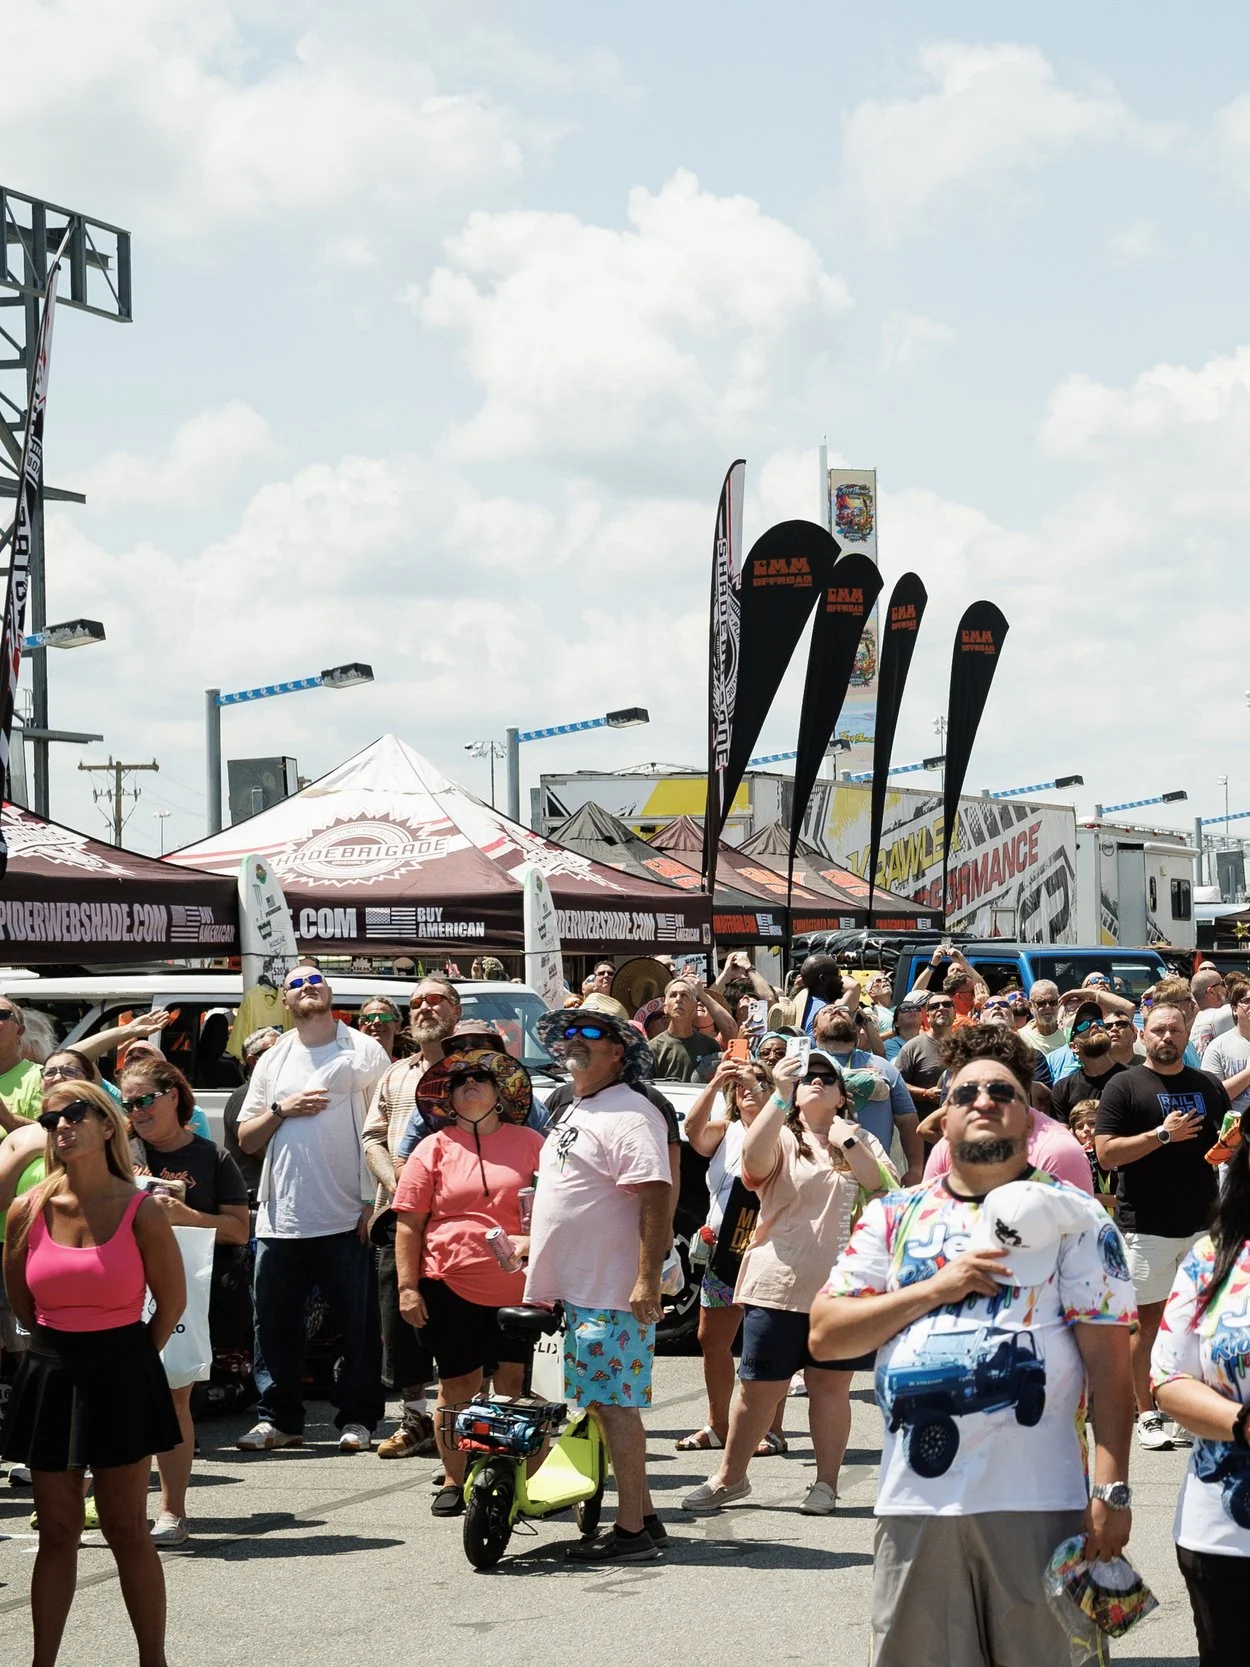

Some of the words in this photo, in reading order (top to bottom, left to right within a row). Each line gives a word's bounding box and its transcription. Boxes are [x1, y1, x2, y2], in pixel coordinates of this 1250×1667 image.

[753, 575, 812, 587] OFFROAD
[272, 837, 446, 868] HADEBRIGADE
[911, 820, 1043, 917] RFORMANCE
[200, 906, 214, 924] BUY
[289, 907, 357, 939] .COM
[417, 906, 443, 922] BUY
[199, 924, 235, 943] AMERICAN
[418, 922, 485, 938] AMERICAN
[556, 909, 655, 941] DERWEBSHADE.COM
[675, 913, 685, 928] BUY
[1160, 1095, 1194, 1106] RAIL
[906, 1222, 973, 1262] Je
[742, 1354, 772, 1373] Jeep
